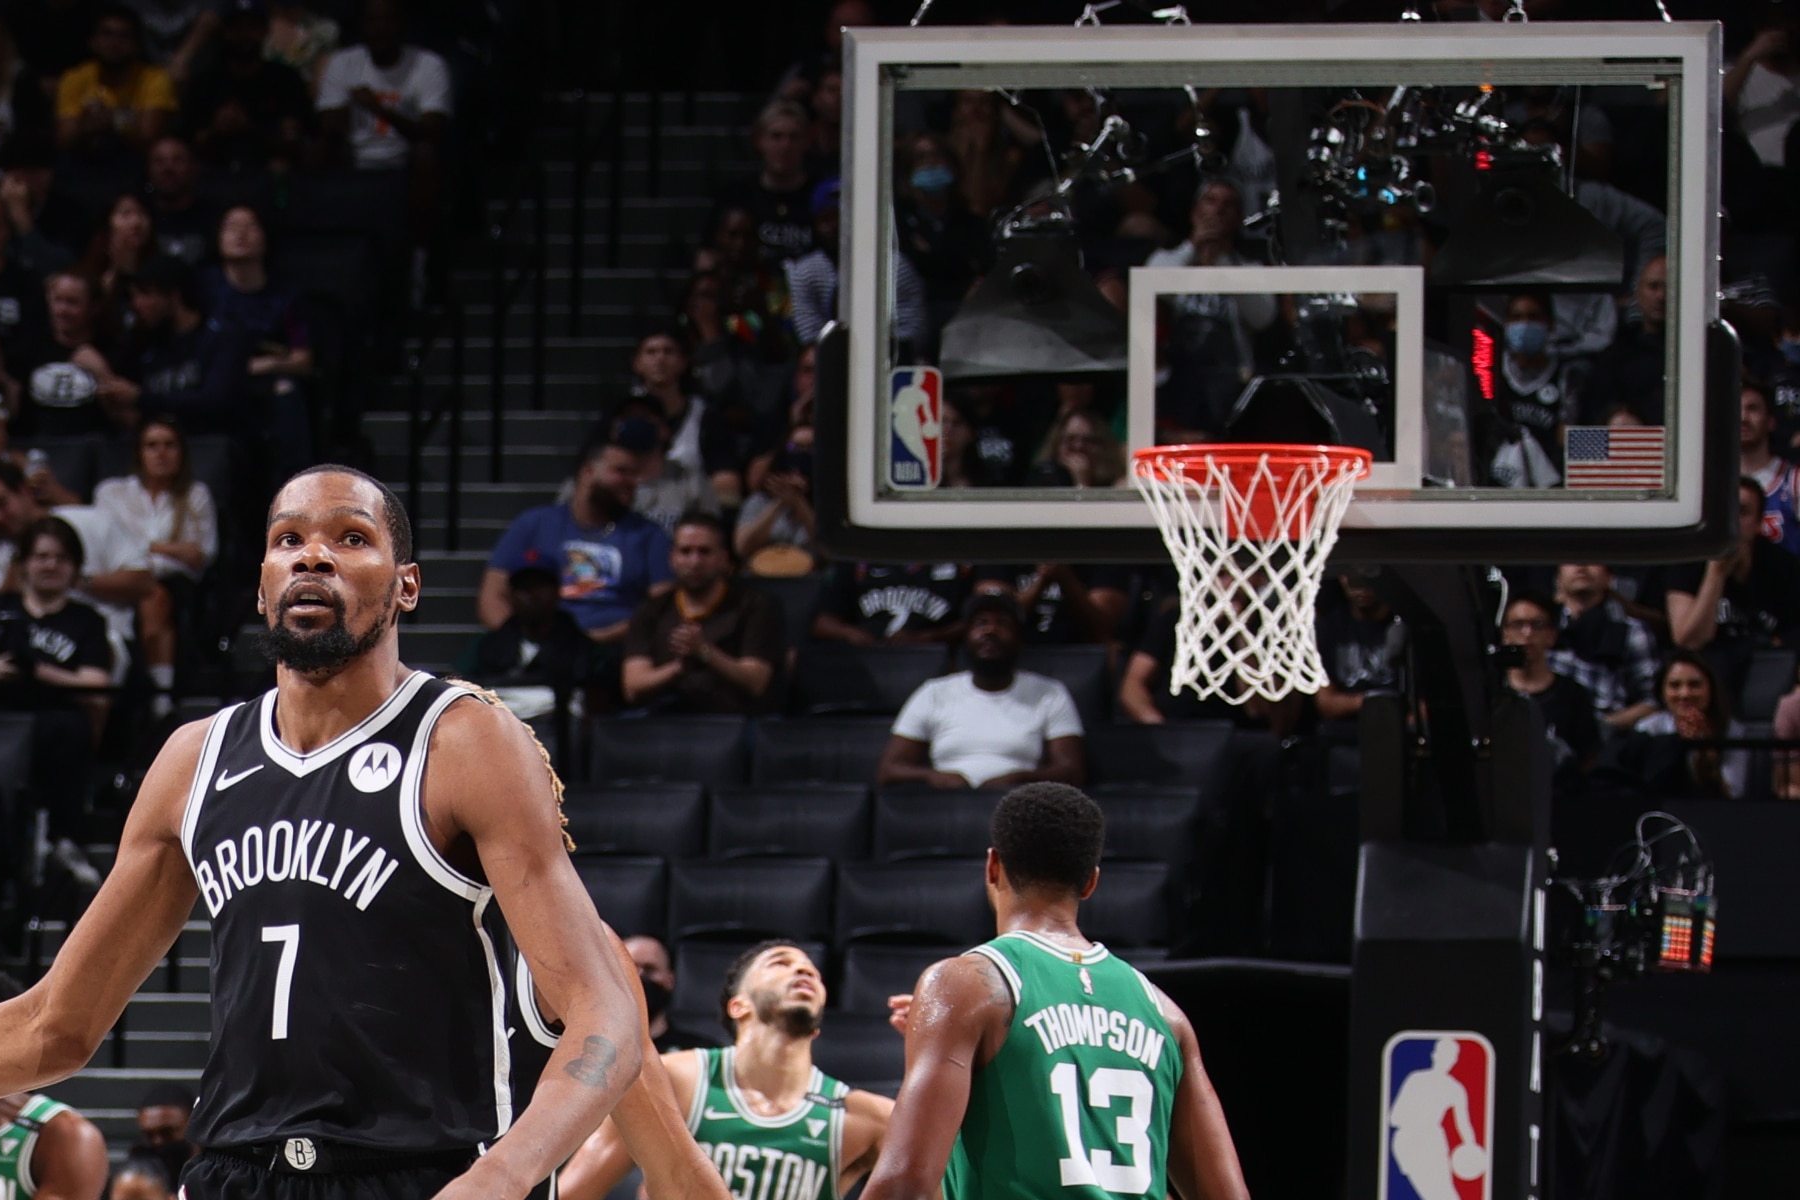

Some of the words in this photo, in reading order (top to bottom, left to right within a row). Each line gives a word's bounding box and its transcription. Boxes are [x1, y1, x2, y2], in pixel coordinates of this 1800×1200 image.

[196, 819, 399, 919] BROOKLYN
[261, 924, 300, 1041] 7
[1024, 1003, 1165, 1070] THOMPSON
[1050, 1062, 1154, 1194] 13
